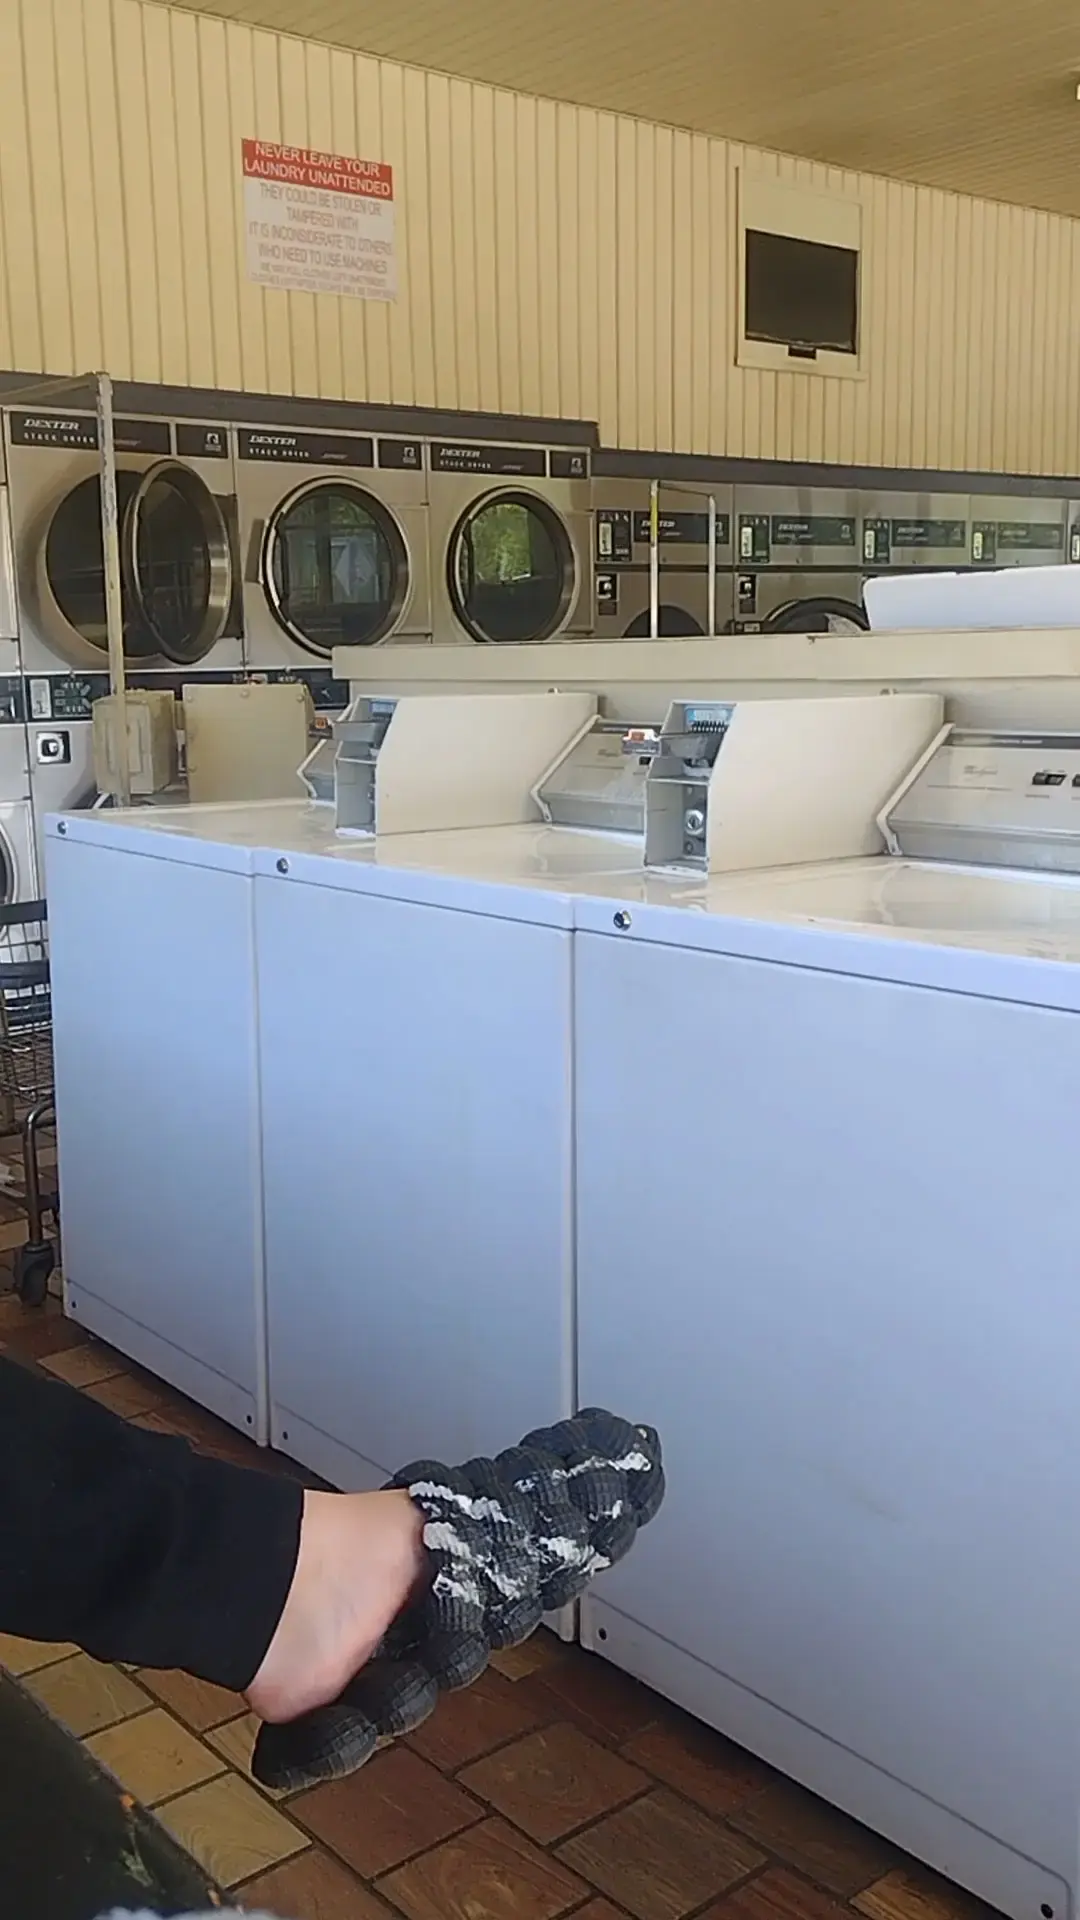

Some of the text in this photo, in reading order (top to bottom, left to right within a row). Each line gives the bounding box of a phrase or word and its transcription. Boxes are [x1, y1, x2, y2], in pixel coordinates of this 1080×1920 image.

[255, 142, 380, 177] NEVER LEAVE YOUR
[244, 159, 391, 196] LAUNDRY UNATTENDED
[260, 182, 382, 216] THEY COULD BE STOLEN OR
[286, 206, 359, 231] TAMPERED WITH
[249, 221, 257, 235] IT
[260, 223, 269, 237] IS
[344, 235, 356, 250] TO
[258, 243, 280, 259] WHO
[283, 246, 307, 264] NEED
[309, 251, 321, 265] TO
[24, 418, 79, 430] DEXTER
[249, 434, 296, 446] DEXTER
[440, 448, 481, 458] DEXTER
